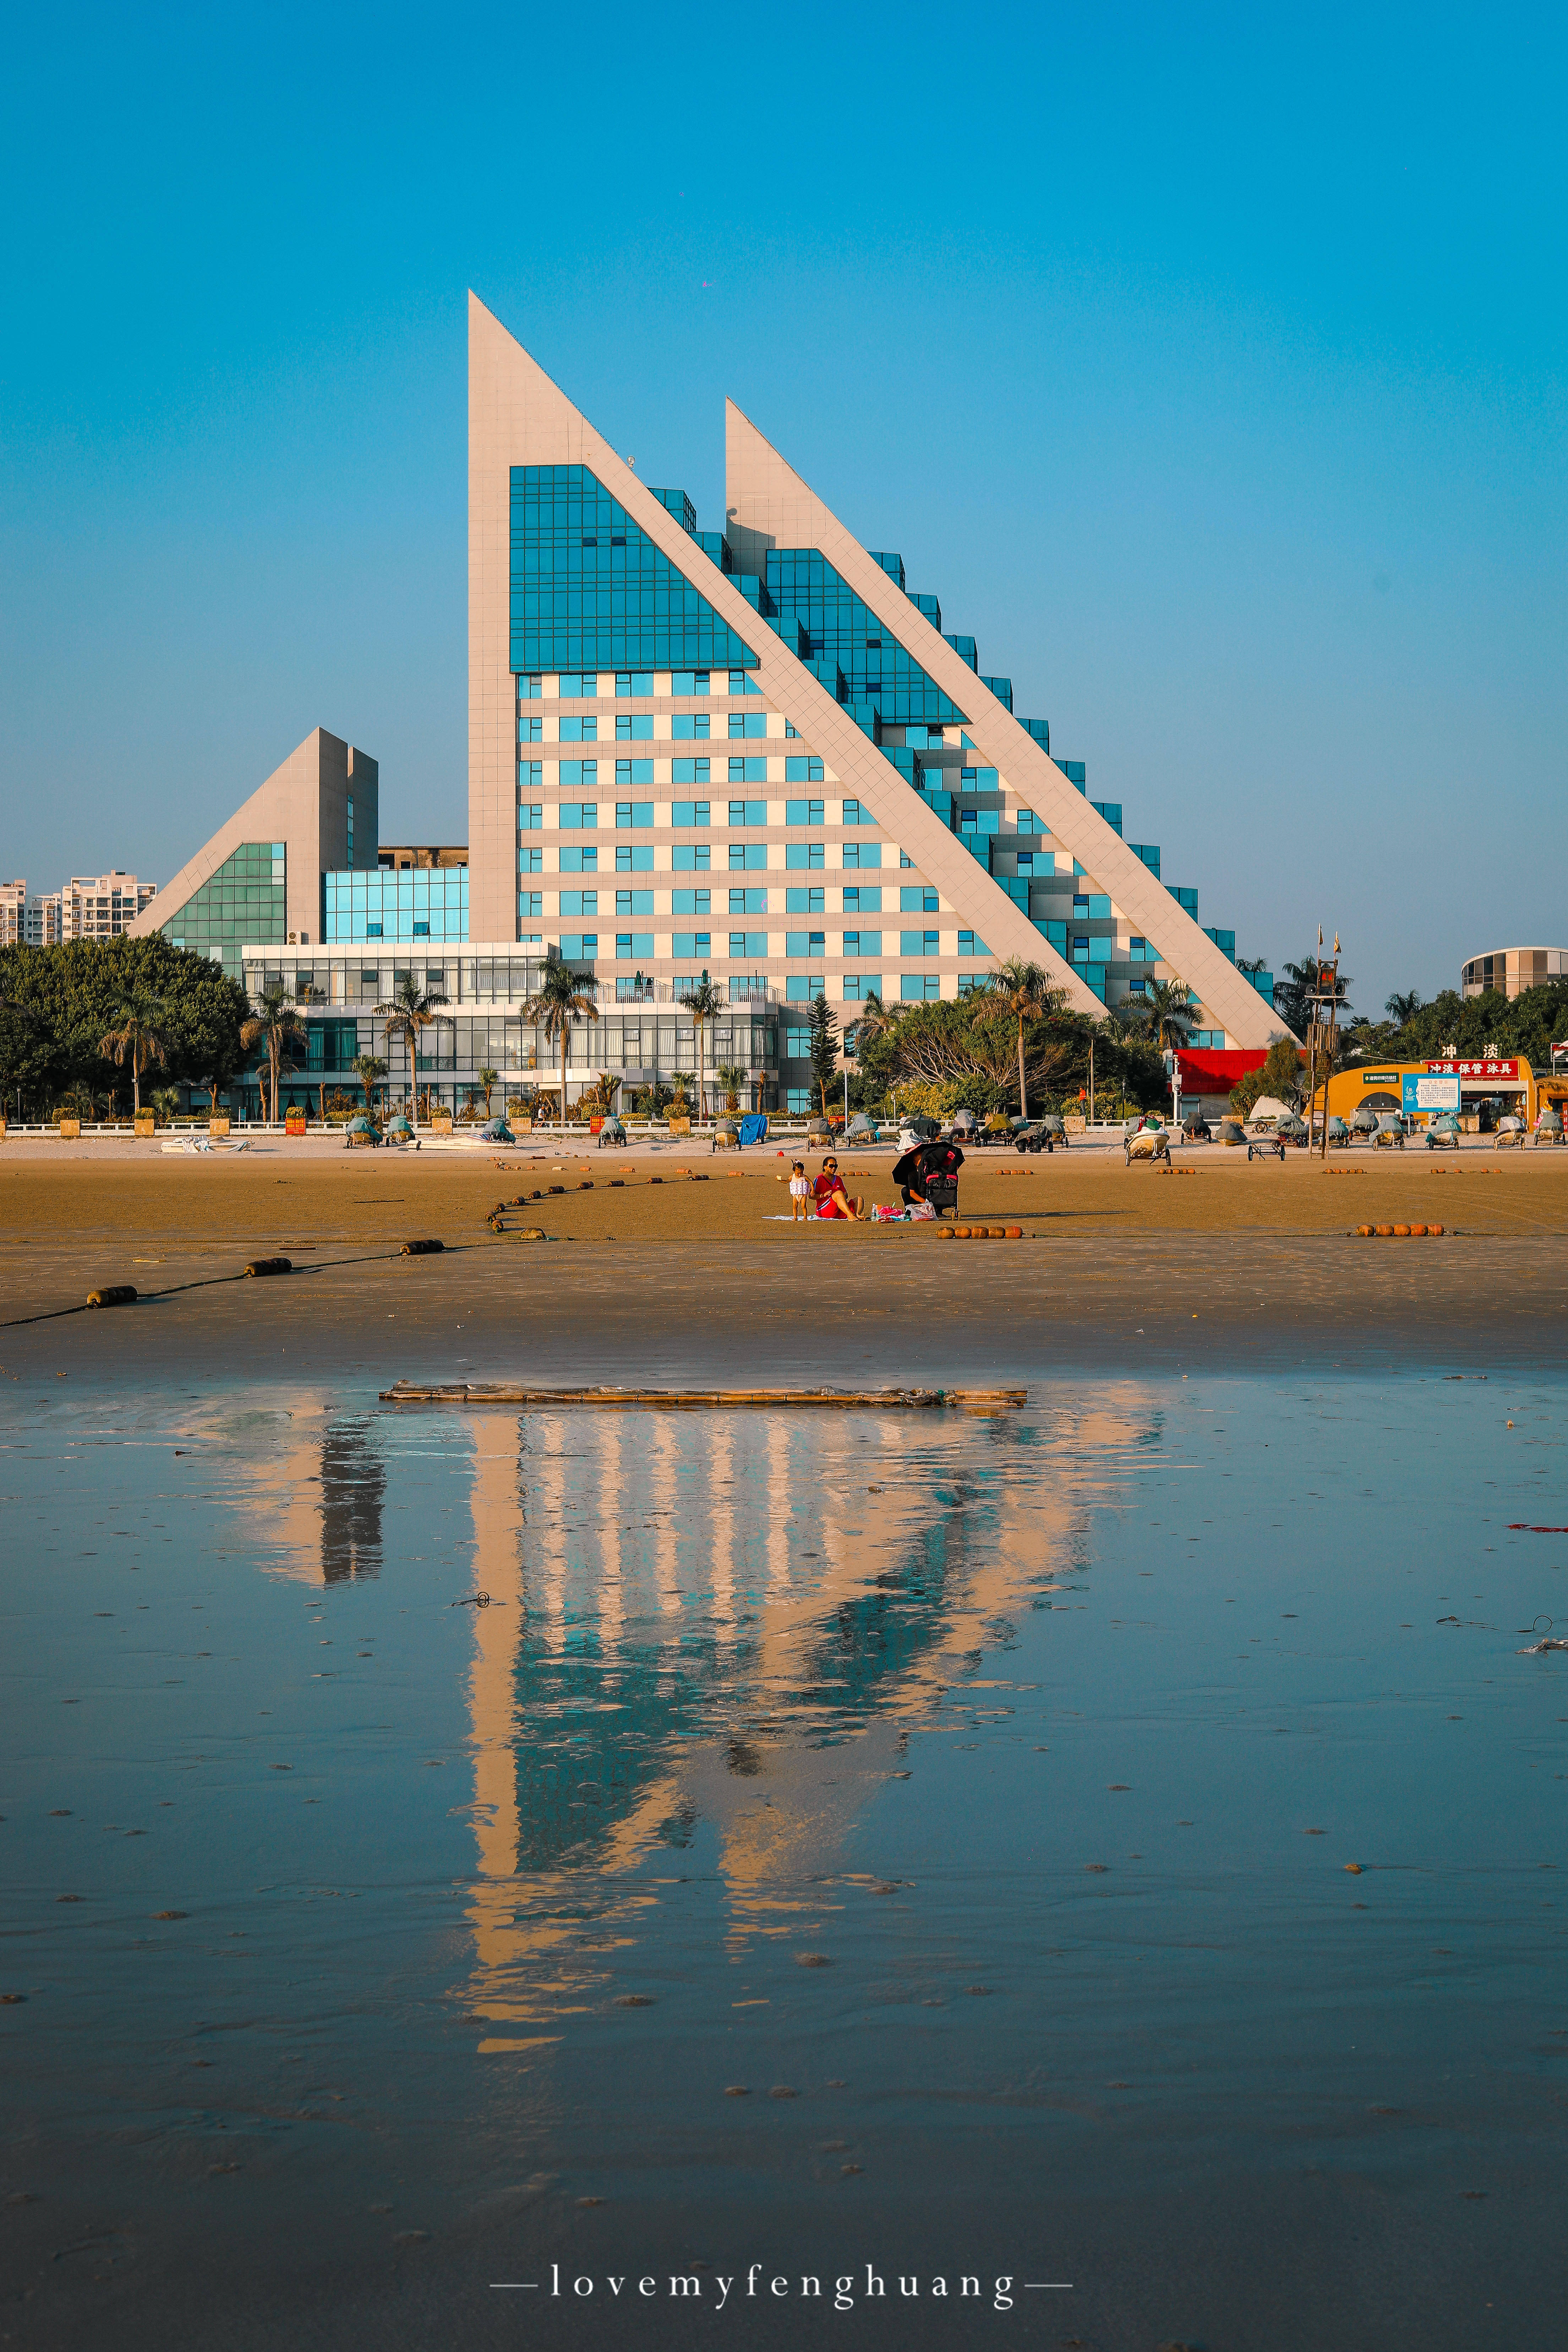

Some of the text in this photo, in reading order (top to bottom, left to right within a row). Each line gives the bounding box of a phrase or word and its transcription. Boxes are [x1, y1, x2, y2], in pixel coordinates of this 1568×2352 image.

[1430, 1063, 1512, 1074] 冲淡 保管 泳具
